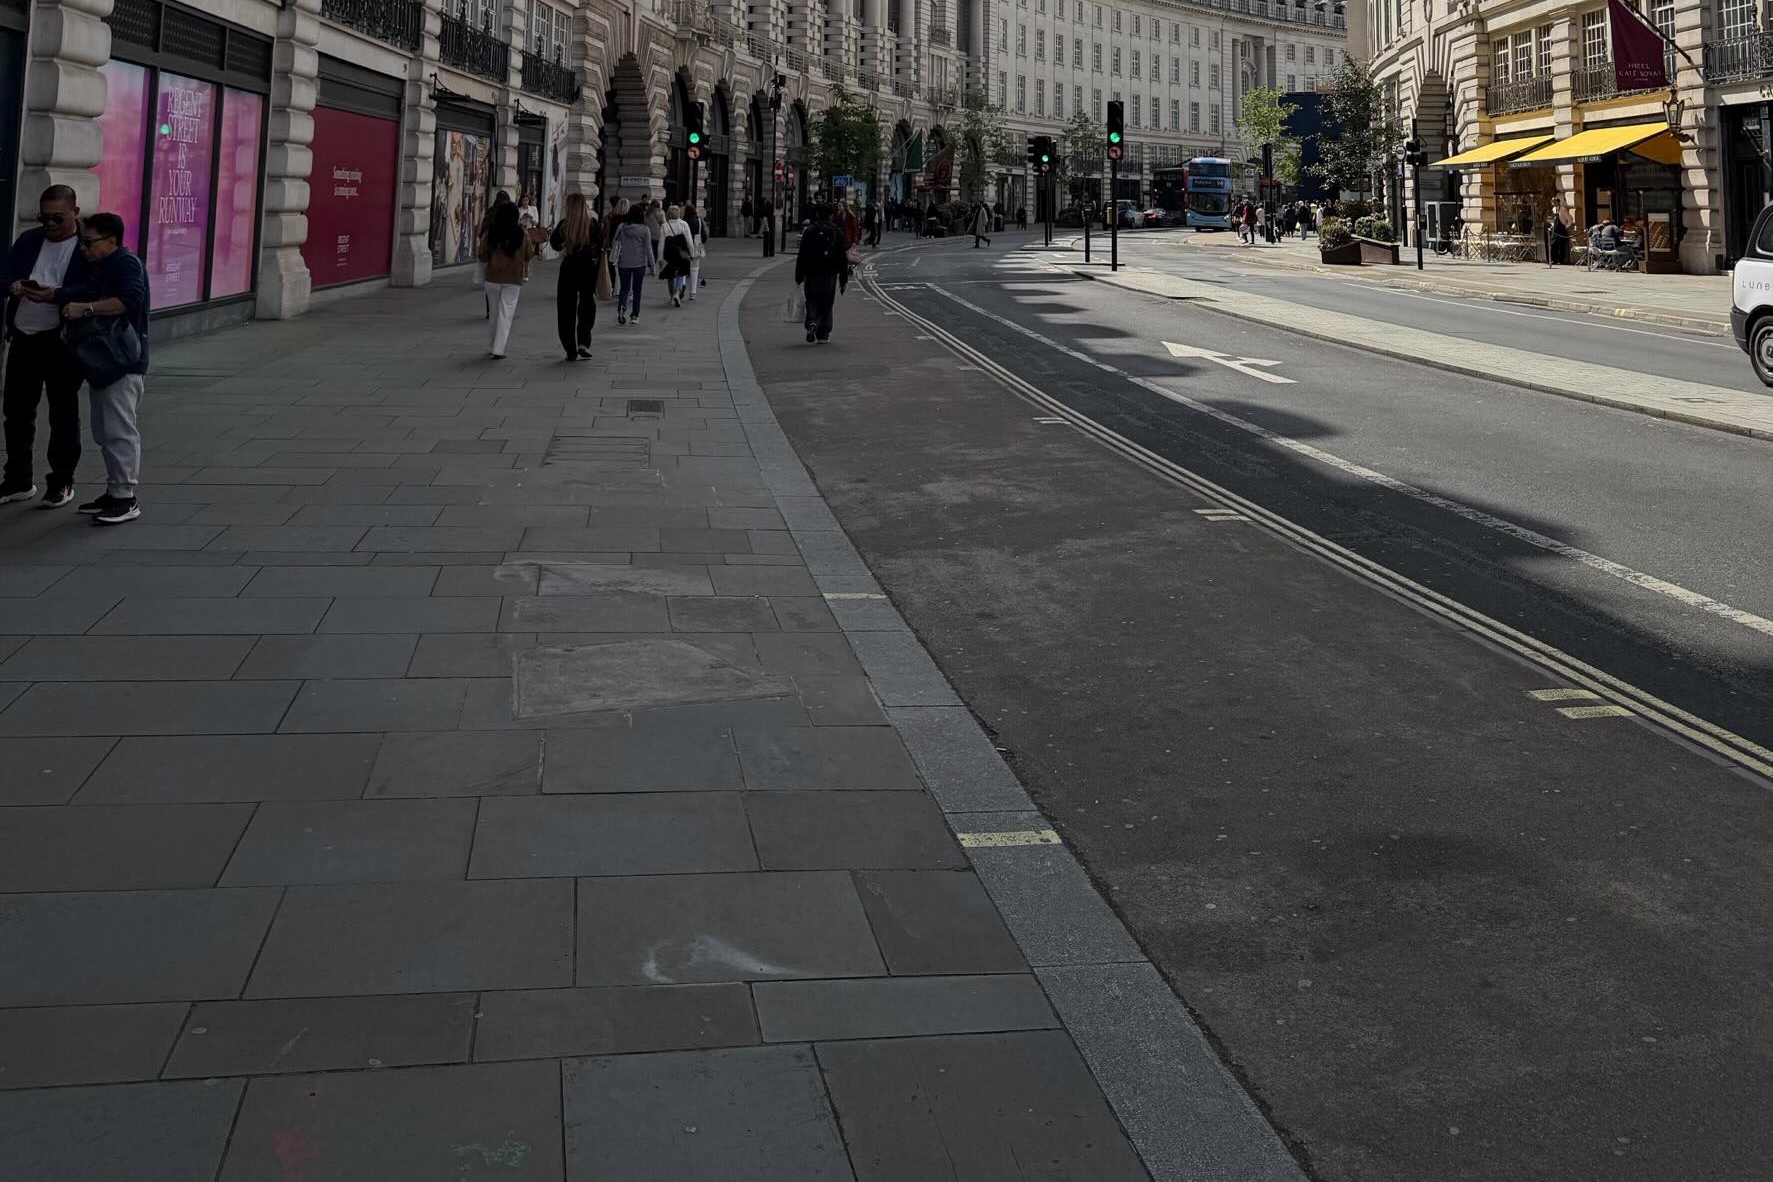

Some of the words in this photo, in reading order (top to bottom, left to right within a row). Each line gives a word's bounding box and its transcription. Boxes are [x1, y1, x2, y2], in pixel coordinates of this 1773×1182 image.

[1628, 62, 1650, 70] HOTEL
[168, 87, 202, 117] REGENT
[167, 113, 200, 144] STREET
[178, 143, 187, 169] IS
[168, 169, 192, 196] YOUR
[158, 197, 196, 224] RUNWAY
